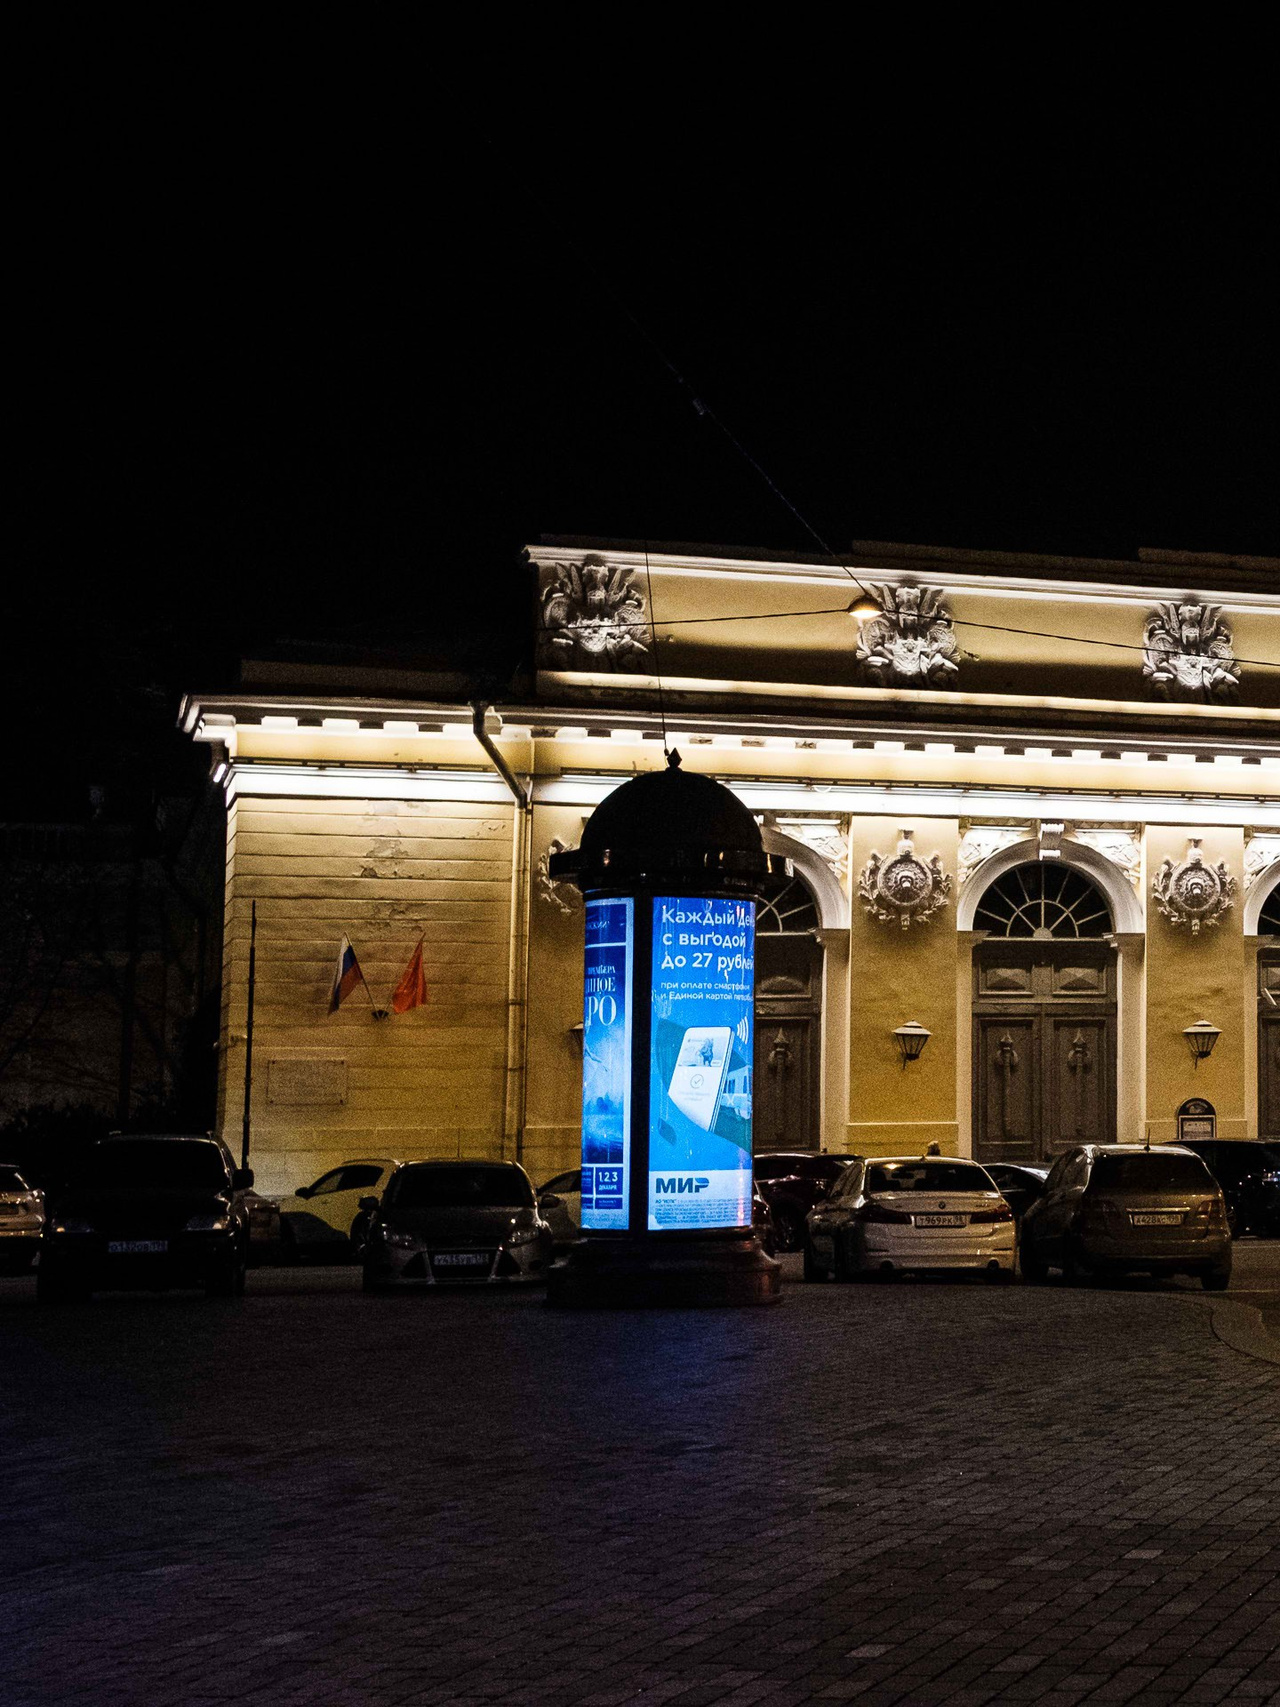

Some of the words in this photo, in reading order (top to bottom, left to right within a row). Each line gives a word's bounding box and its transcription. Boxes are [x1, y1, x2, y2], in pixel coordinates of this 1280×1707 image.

[662, 906, 735, 926] Каждый
[662, 933, 673, 946] с
[679, 932, 746, 949] выгодой
[661, 954, 687, 970] до
[692, 953, 713, 968] 27
[661, 982, 679, 990] при
[669, 991, 703, 1001] Единой
[706, 992, 733, 1001] картой
[655, 1177, 709, 1194] МИР
